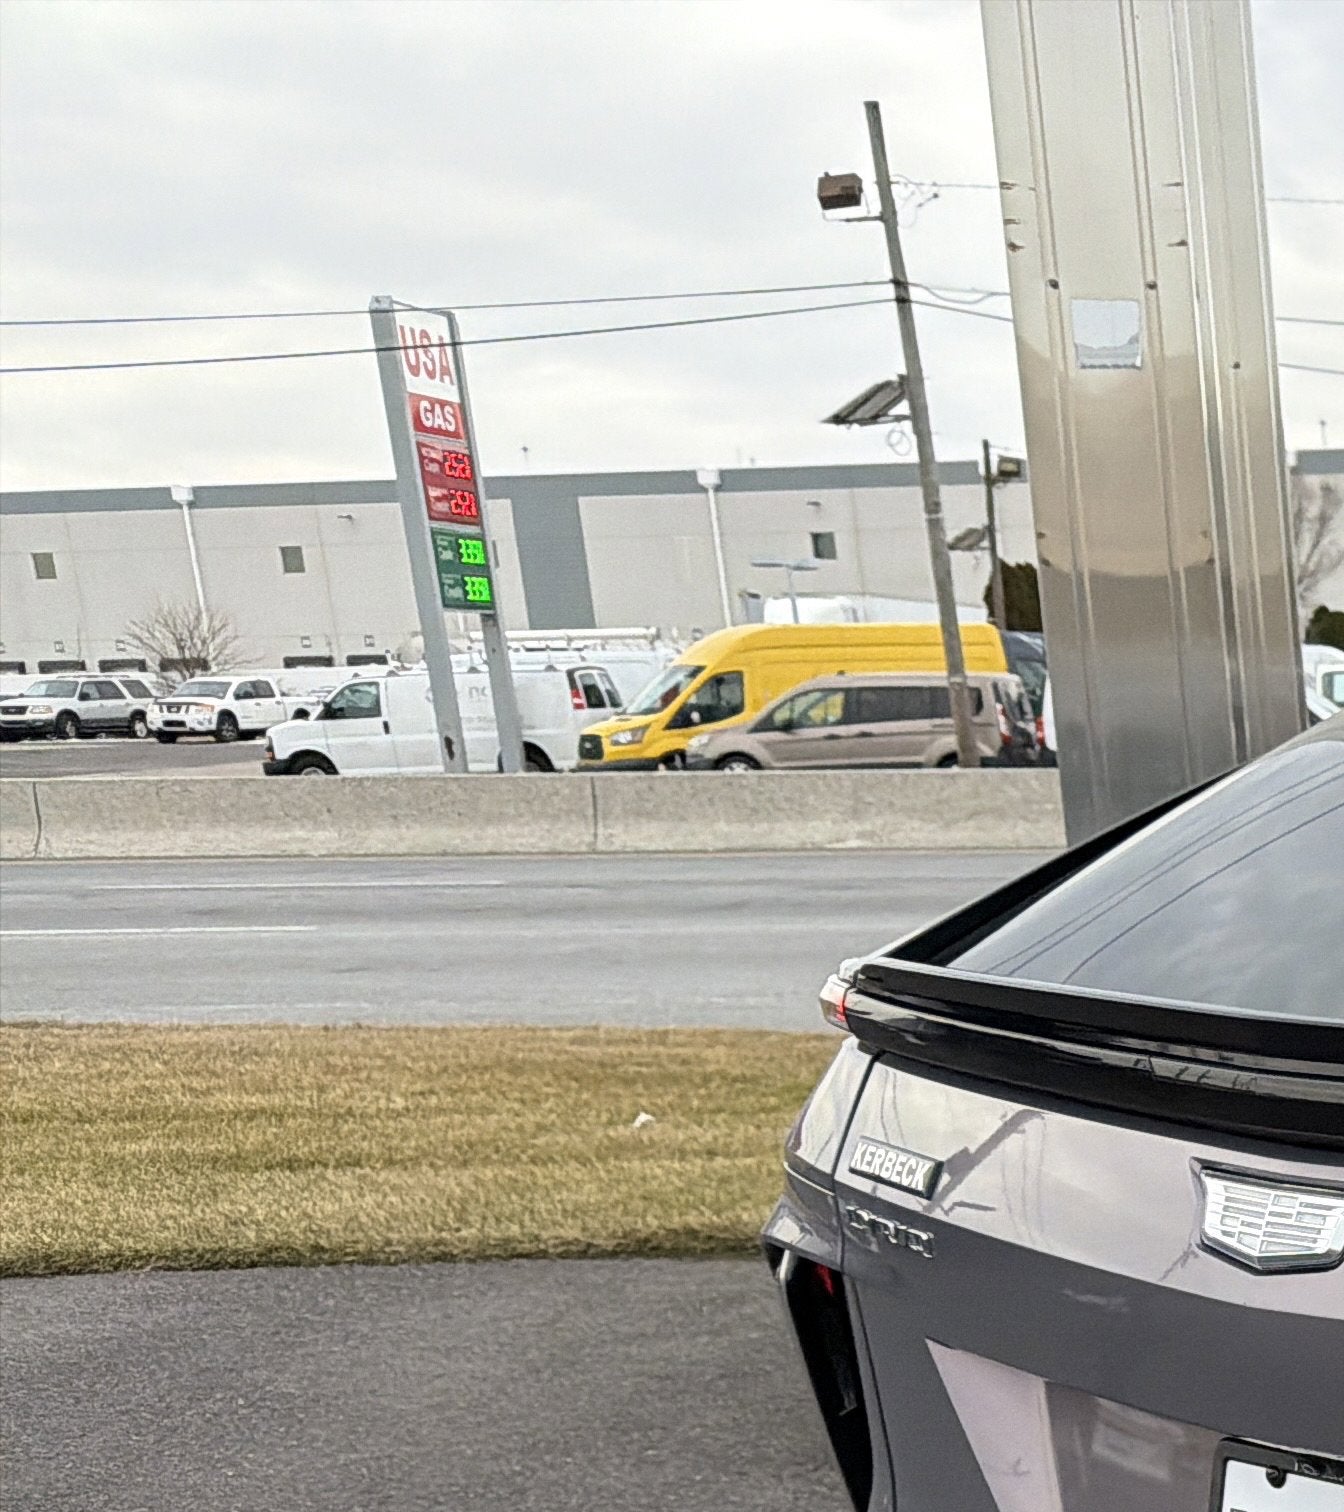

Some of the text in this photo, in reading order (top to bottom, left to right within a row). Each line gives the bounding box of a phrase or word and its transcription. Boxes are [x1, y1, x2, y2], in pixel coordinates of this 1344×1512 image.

[399, 324, 455, 386] USA
[419, 400, 457, 433] GAS
[851, 1142, 934, 1191] KERBECK
